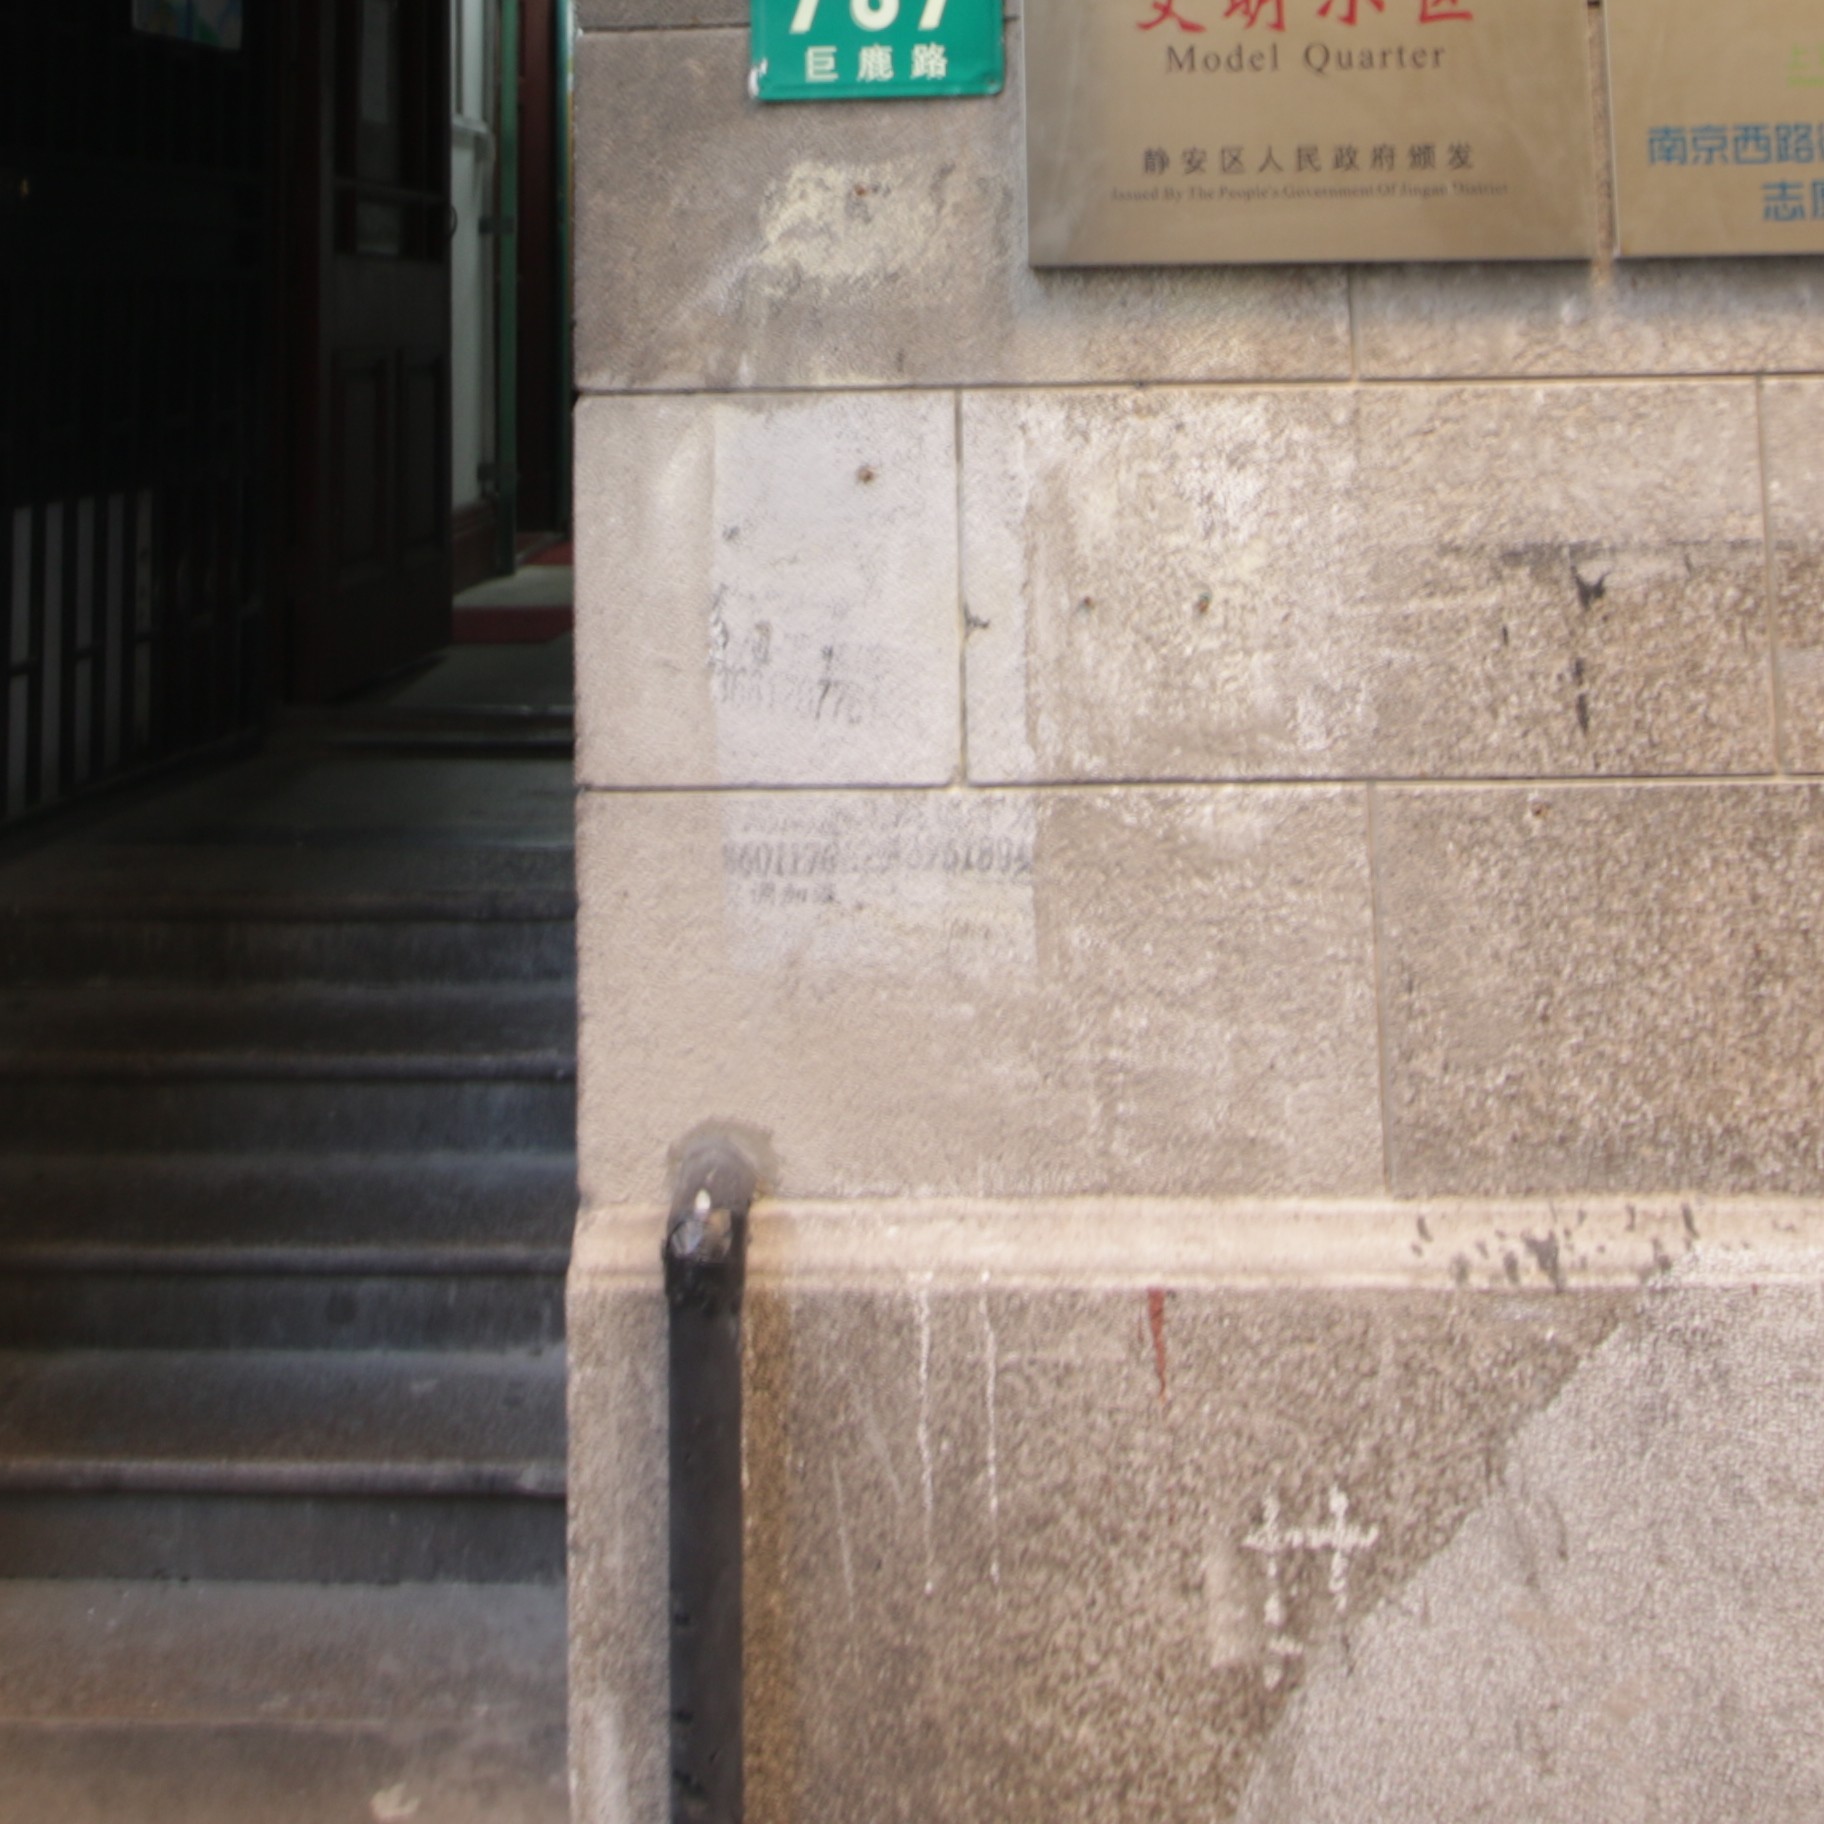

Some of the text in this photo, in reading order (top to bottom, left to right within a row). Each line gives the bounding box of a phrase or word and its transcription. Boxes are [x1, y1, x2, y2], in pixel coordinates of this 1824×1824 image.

[805, 42, 947, 83] 巨鹿路
[1166, 42, 1446, 76] Model Quarter
[1142, 141, 1474, 176] 静安区人民政府颁发
